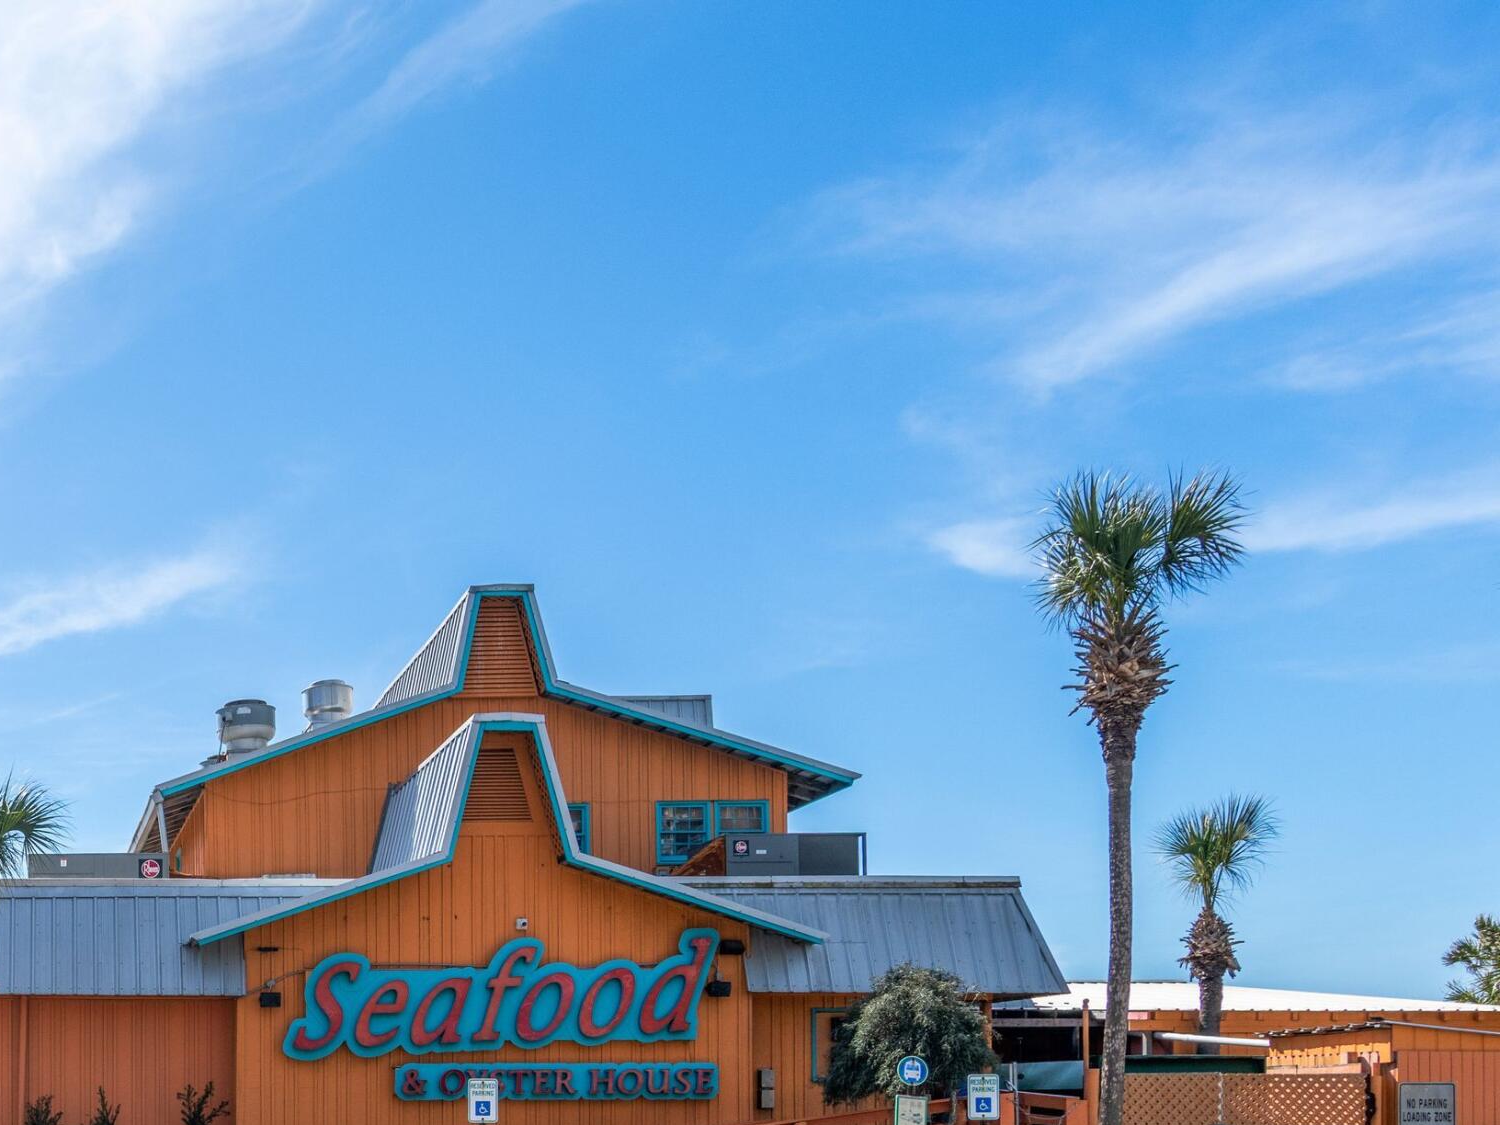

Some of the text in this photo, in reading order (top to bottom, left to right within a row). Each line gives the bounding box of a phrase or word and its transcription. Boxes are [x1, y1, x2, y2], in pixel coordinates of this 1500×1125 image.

[293, 937, 713, 1051] Seafood
[402, 1069, 427, 1095] &
[591, 1069, 714, 1096] HOUSE
[1407, 1099, 1448, 1108] NO PARKING
[1403, 1112, 1452, 1122] LOADING ZONE
